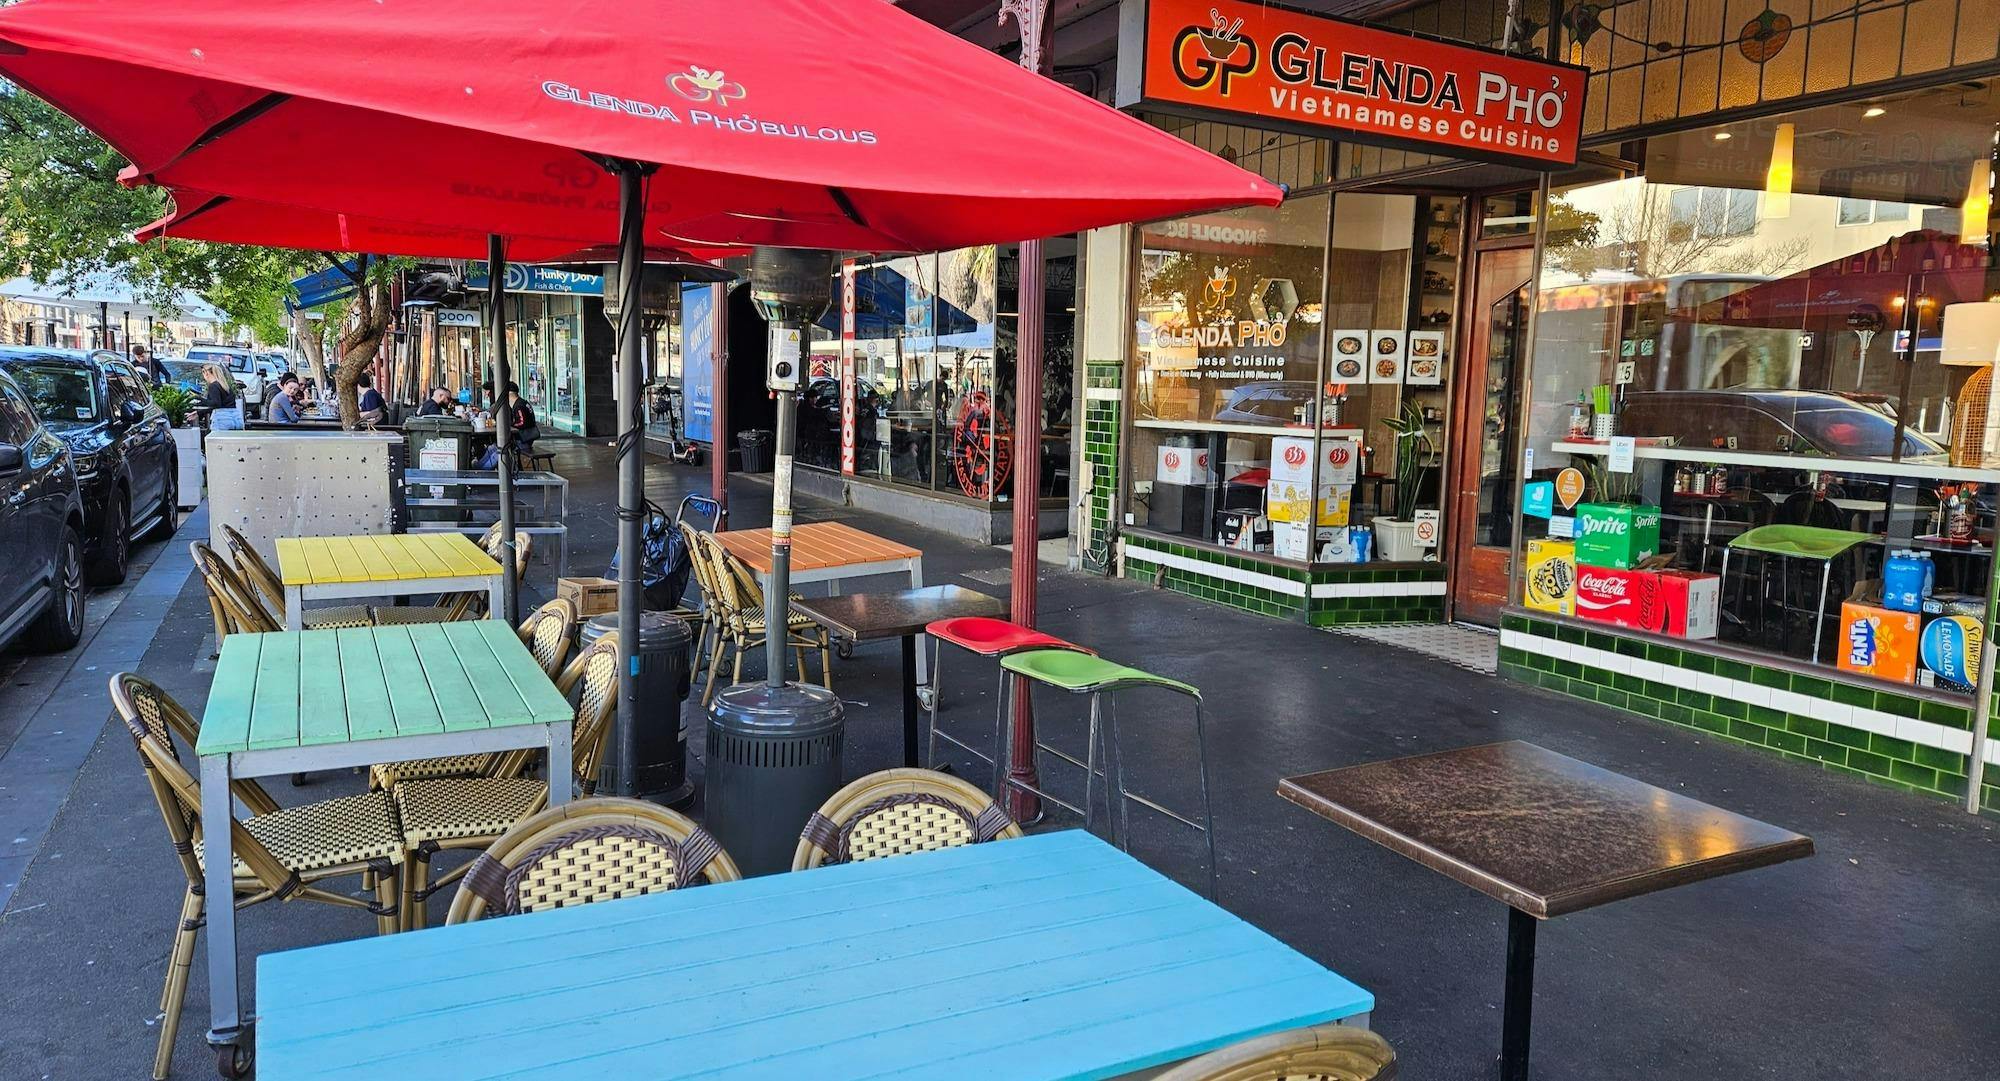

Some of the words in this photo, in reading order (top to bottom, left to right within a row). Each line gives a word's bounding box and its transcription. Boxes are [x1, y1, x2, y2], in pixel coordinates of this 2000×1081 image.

[1269, 31, 1465, 114] GLENDA
[1474, 70, 1568, 129] PHỞ
[541, 80, 682, 123] GLENDA
[1269, 86, 1450, 136] Vietnamese
[1459, 119, 1560, 154] Cuisine
[534, 267, 570, 284] Hunky
[571, 271, 599, 285] Dory
[555, 283, 572, 292] Chips
[843, 263, 854, 333] BOX
[1156, 325, 1234, 348] GLENDA
[1233, 354, 1285, 367] Cuisine
[1208, 371, 1220, 380] Fully
[435, 441, 456, 449] CSC
[1582, 513, 1628, 536] Sprite
[1634, 515, 1658, 529] Sprite
[1543, 559, 1562, 597] SOLO
[1580, 573, 1629, 596] Coca-Cola
[1849, 619, 1870, 666] FANTA
[1941, 620, 1955, 678] LEMONADE
